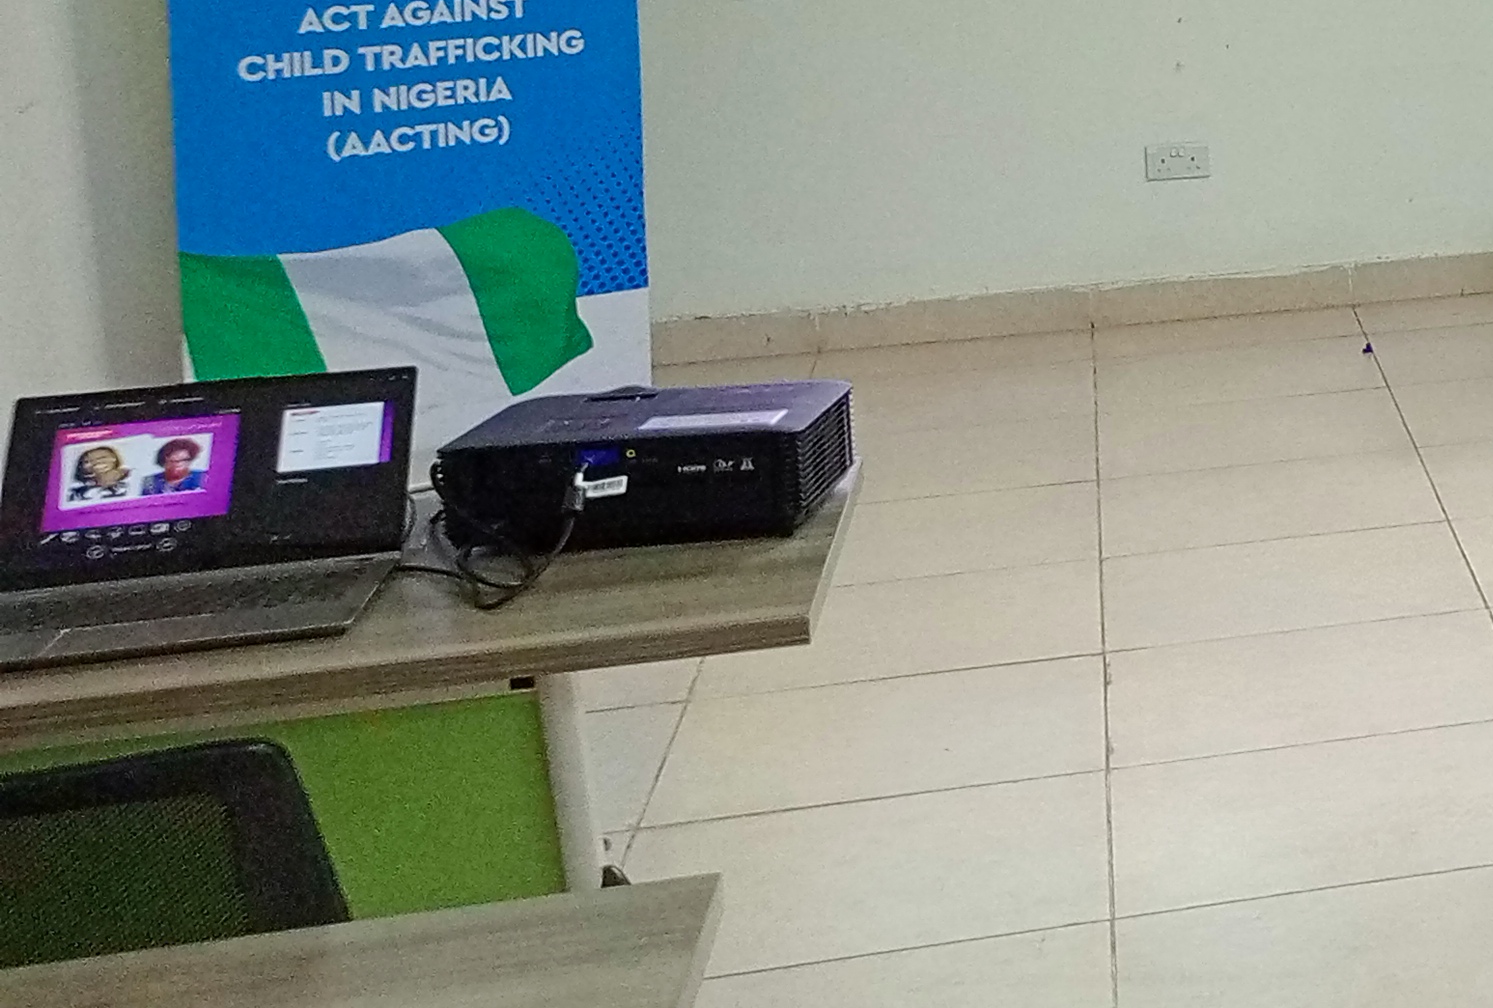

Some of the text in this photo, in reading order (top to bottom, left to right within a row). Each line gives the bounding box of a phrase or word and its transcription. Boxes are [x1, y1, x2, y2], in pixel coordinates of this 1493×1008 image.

[297, 4, 375, 34] ACT
[237, 29, 585, 82] CHILD TRAFFICKING
[322, 76, 513, 117] IN NIGERIA
[327, 115, 511, 162] (AACTING)
